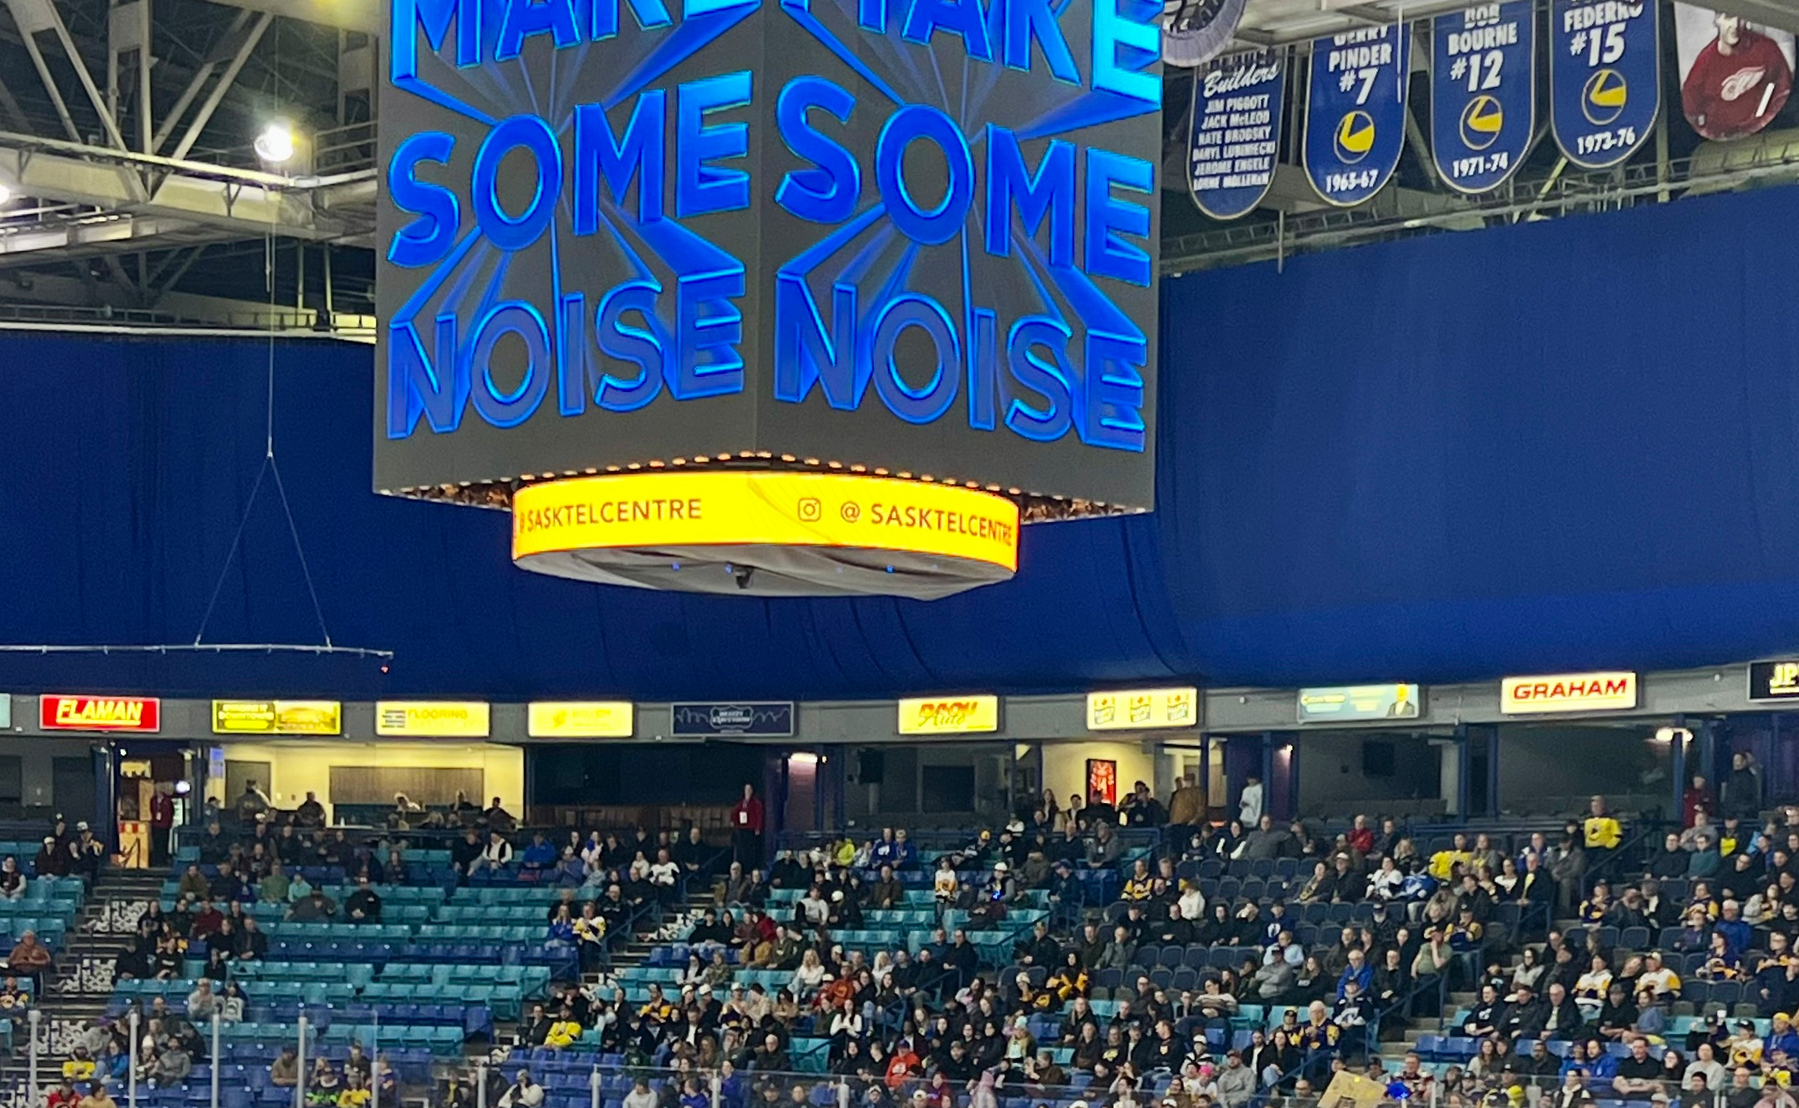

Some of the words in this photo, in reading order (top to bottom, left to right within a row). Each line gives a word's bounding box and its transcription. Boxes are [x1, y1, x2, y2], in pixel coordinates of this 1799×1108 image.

[1447, 22, 1518, 56] BOURNE
[1569, 22, 1627, 67] #15
[1328, 43, 1392, 73] PINDER
[1450, 49, 1504, 92] #12
[1203, 61, 1279, 98] Builders
[1339, 67, 1379, 105] #7
[1201, 114, 1228, 130] JACK
[1577, 126, 1636, 156] 1973-76
[388, 70, 752, 267] SOME
[775, 75, 1154, 288] SOME
[1452, 152, 1509, 178] 1971-74
[387, 268, 745, 440] NOISE
[774, 270, 1147, 452] NOISE
[527, 498, 703, 532] SASKTELCENTRE
[840, 501, 861, 523] @
[870, 503, 1012, 547] SASKTELCENTRE
[1513, 679, 1627, 700] GRAHAM
[1769, 662, 1799, 687] JP
[56, 699, 143, 721] FLAMAN
